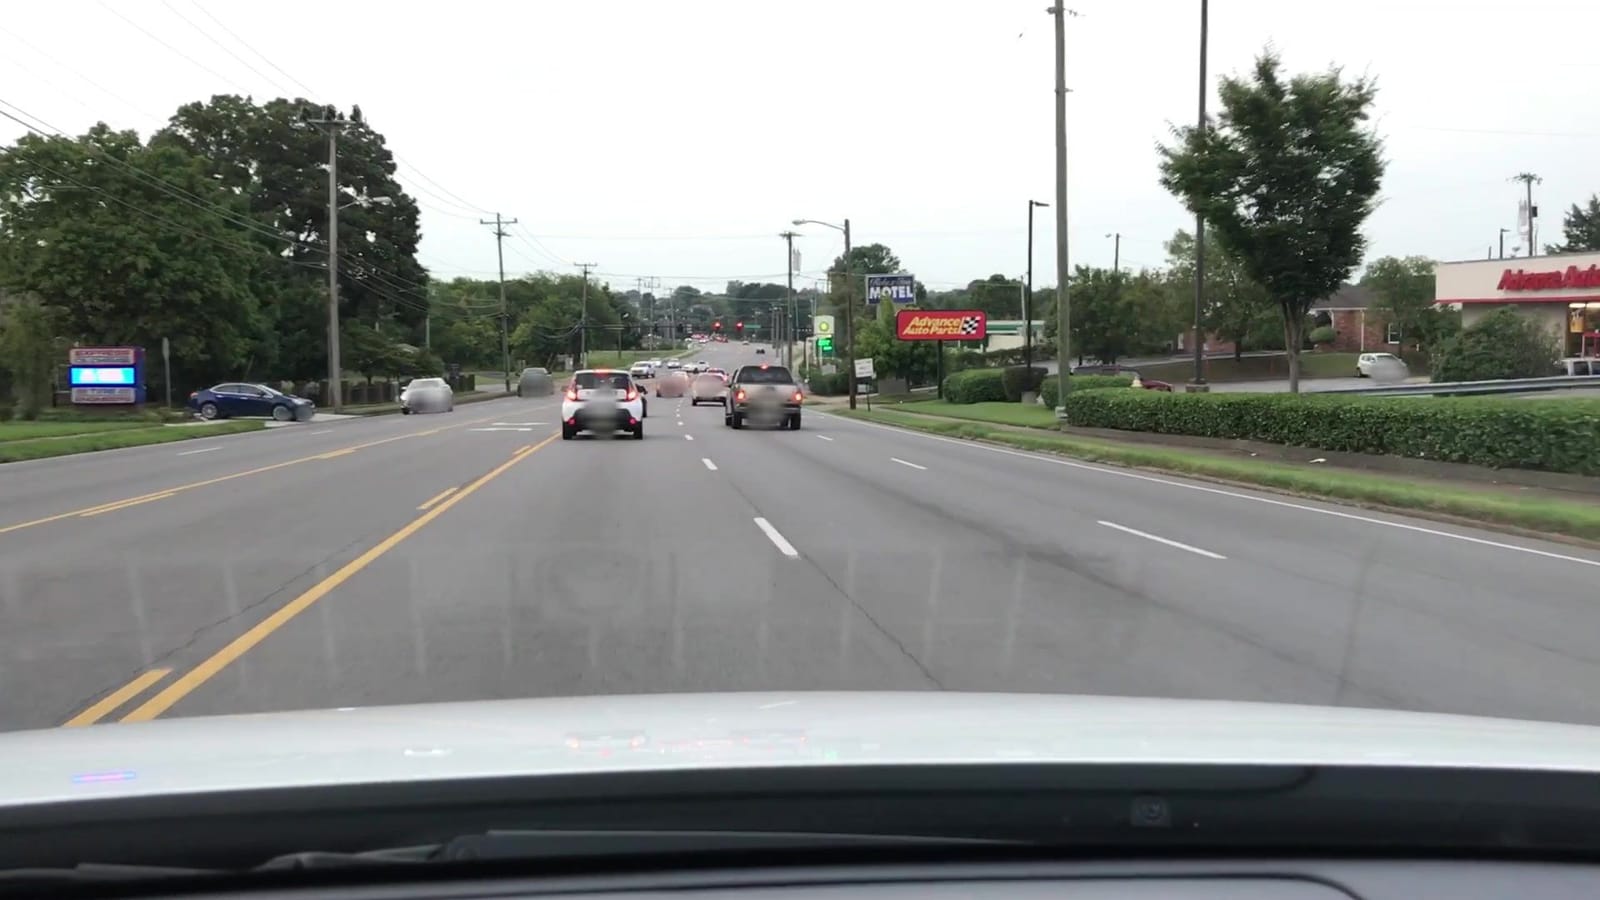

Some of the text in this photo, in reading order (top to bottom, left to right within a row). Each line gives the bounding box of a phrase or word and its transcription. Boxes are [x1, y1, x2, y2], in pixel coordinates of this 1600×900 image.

[869, 285, 913, 299] MOTEL
[909, 316, 961, 327] Advance
[903, 325, 961, 335] Auto Parts
